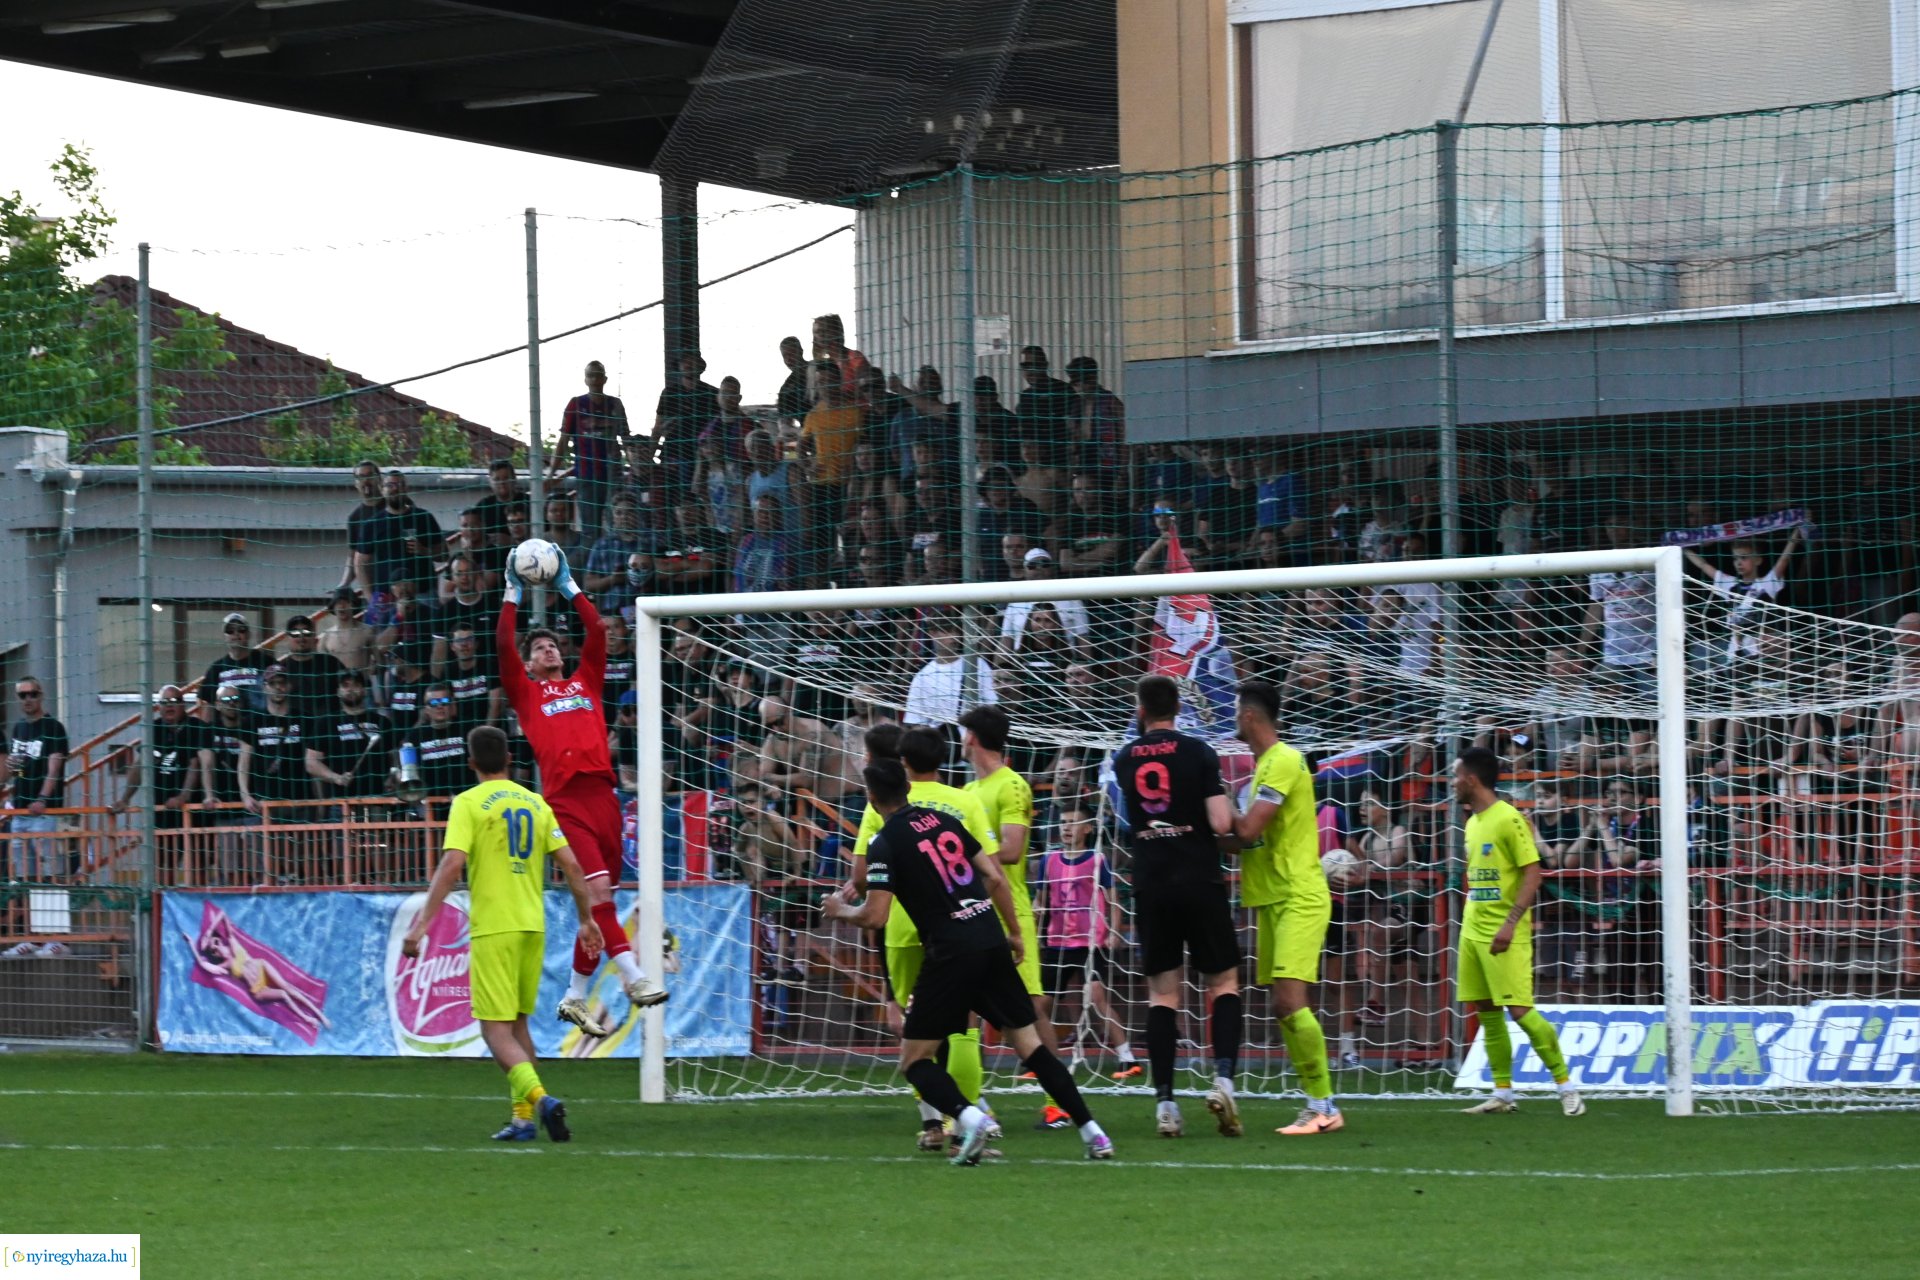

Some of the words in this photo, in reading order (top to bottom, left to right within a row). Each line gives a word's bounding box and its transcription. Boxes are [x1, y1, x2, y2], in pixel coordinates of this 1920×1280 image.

[1135, 761, 1171, 814] 9
[502, 807, 534, 860] 10
[917, 831, 974, 894] 18
